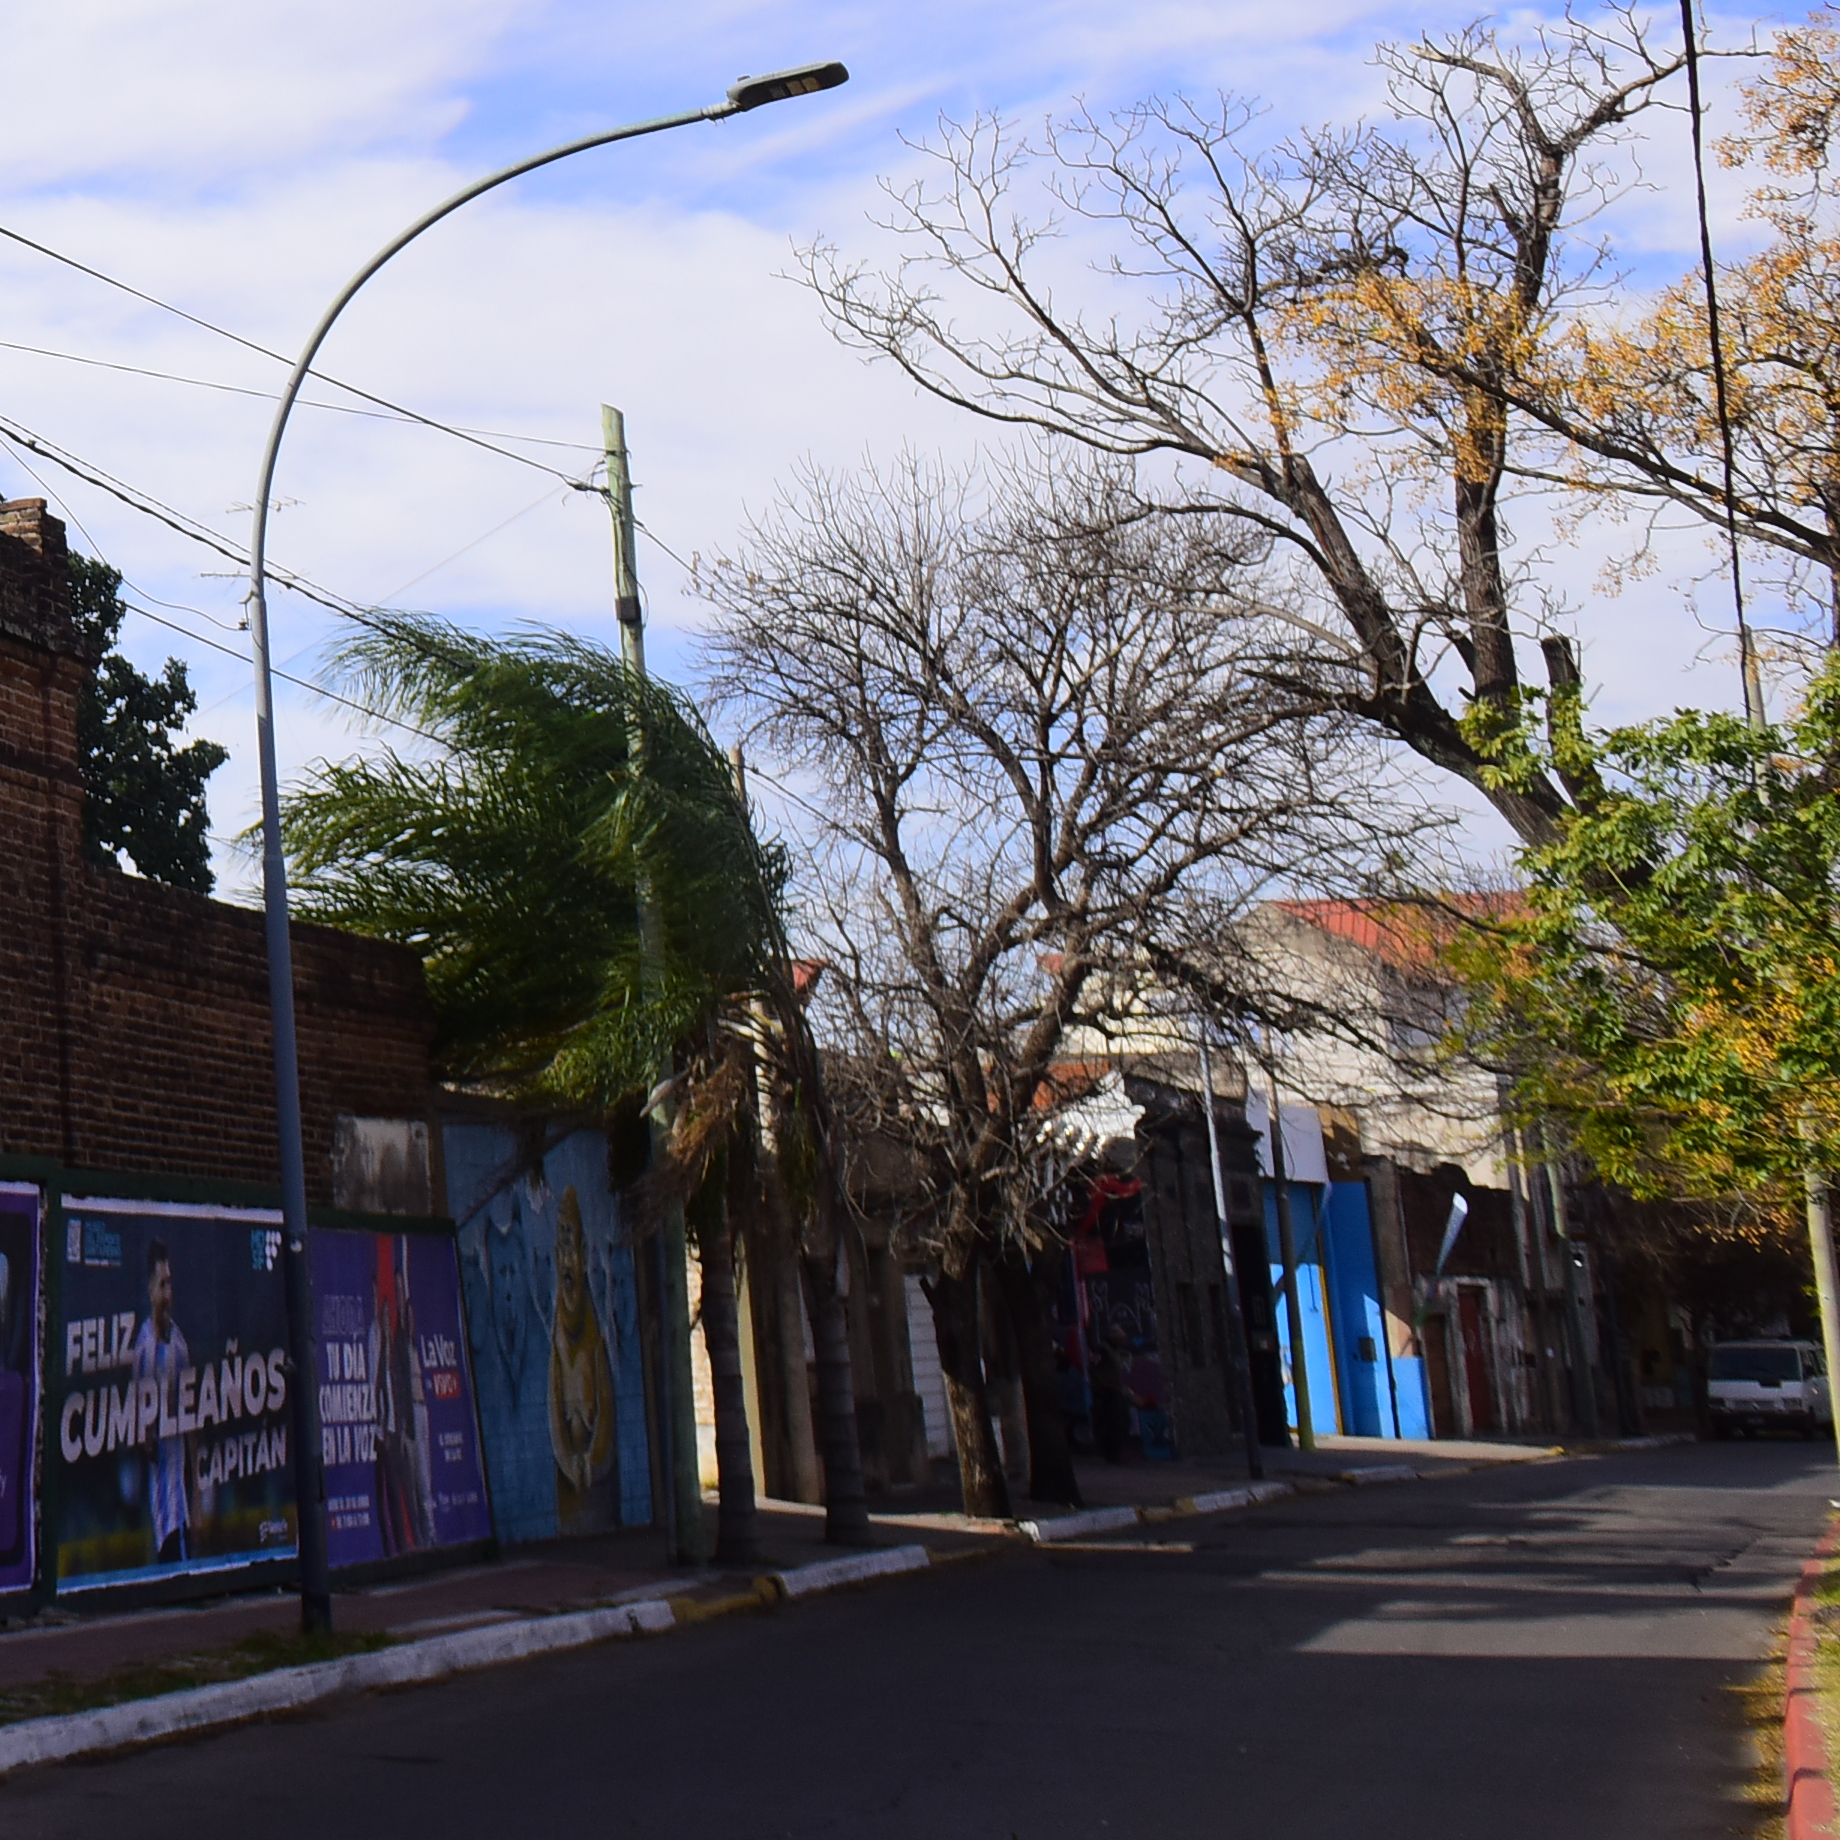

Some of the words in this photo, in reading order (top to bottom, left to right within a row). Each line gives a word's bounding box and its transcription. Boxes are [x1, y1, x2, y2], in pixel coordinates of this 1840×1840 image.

[66, 1311, 136, 1377] FELIZ
[60, 1336, 287, 1464] CUMPLEAÑOS
[196, 1418, 287, 1491] CAPITÁN
